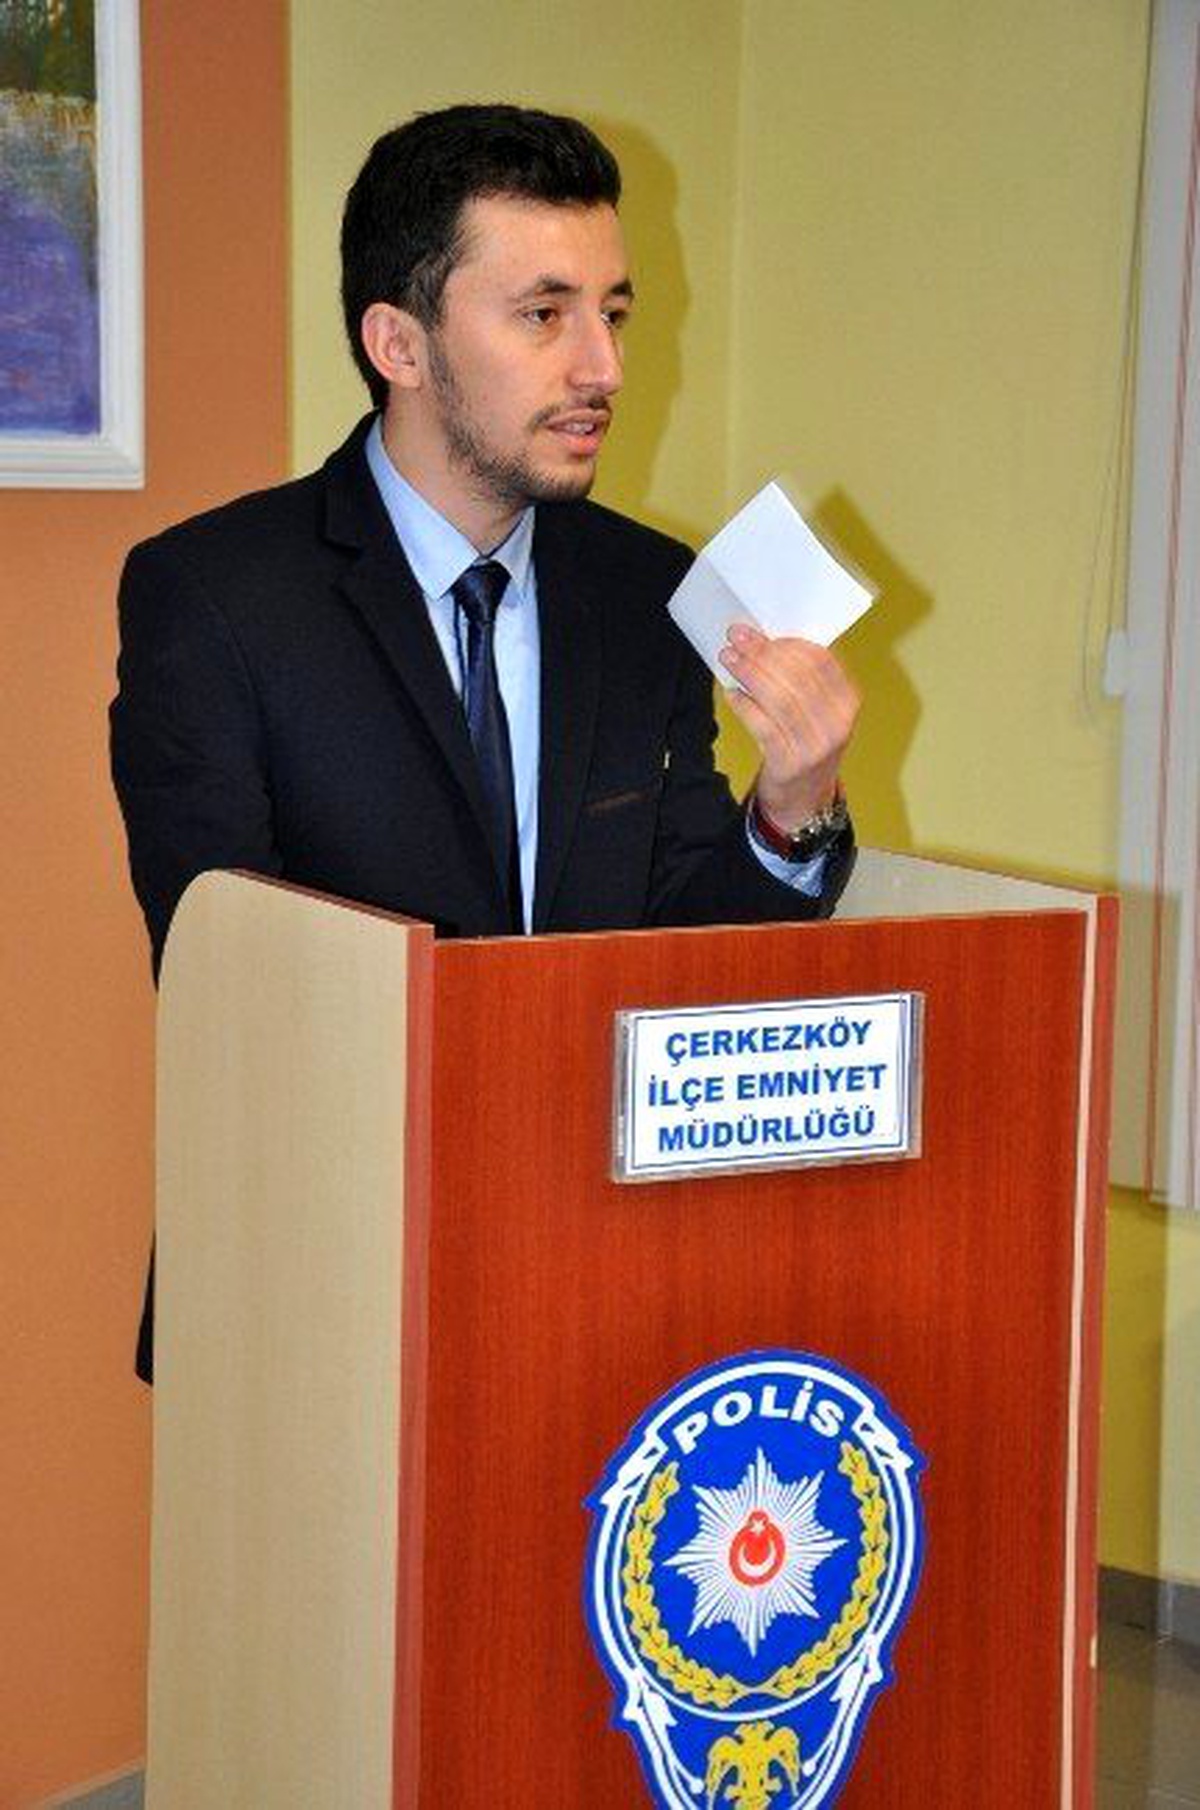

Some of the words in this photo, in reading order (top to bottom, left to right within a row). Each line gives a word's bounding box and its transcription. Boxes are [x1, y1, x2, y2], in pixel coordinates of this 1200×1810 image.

[665, 1016, 872, 1067] ÇERKEZKÖY
[648, 1074, 725, 1111] İLÇE
[737, 1063, 887, 1100] EMNİYET
[658, 1105, 876, 1153] MÜDÜRLÜĞÜ
[672, 1380, 846, 1454] POLİS
